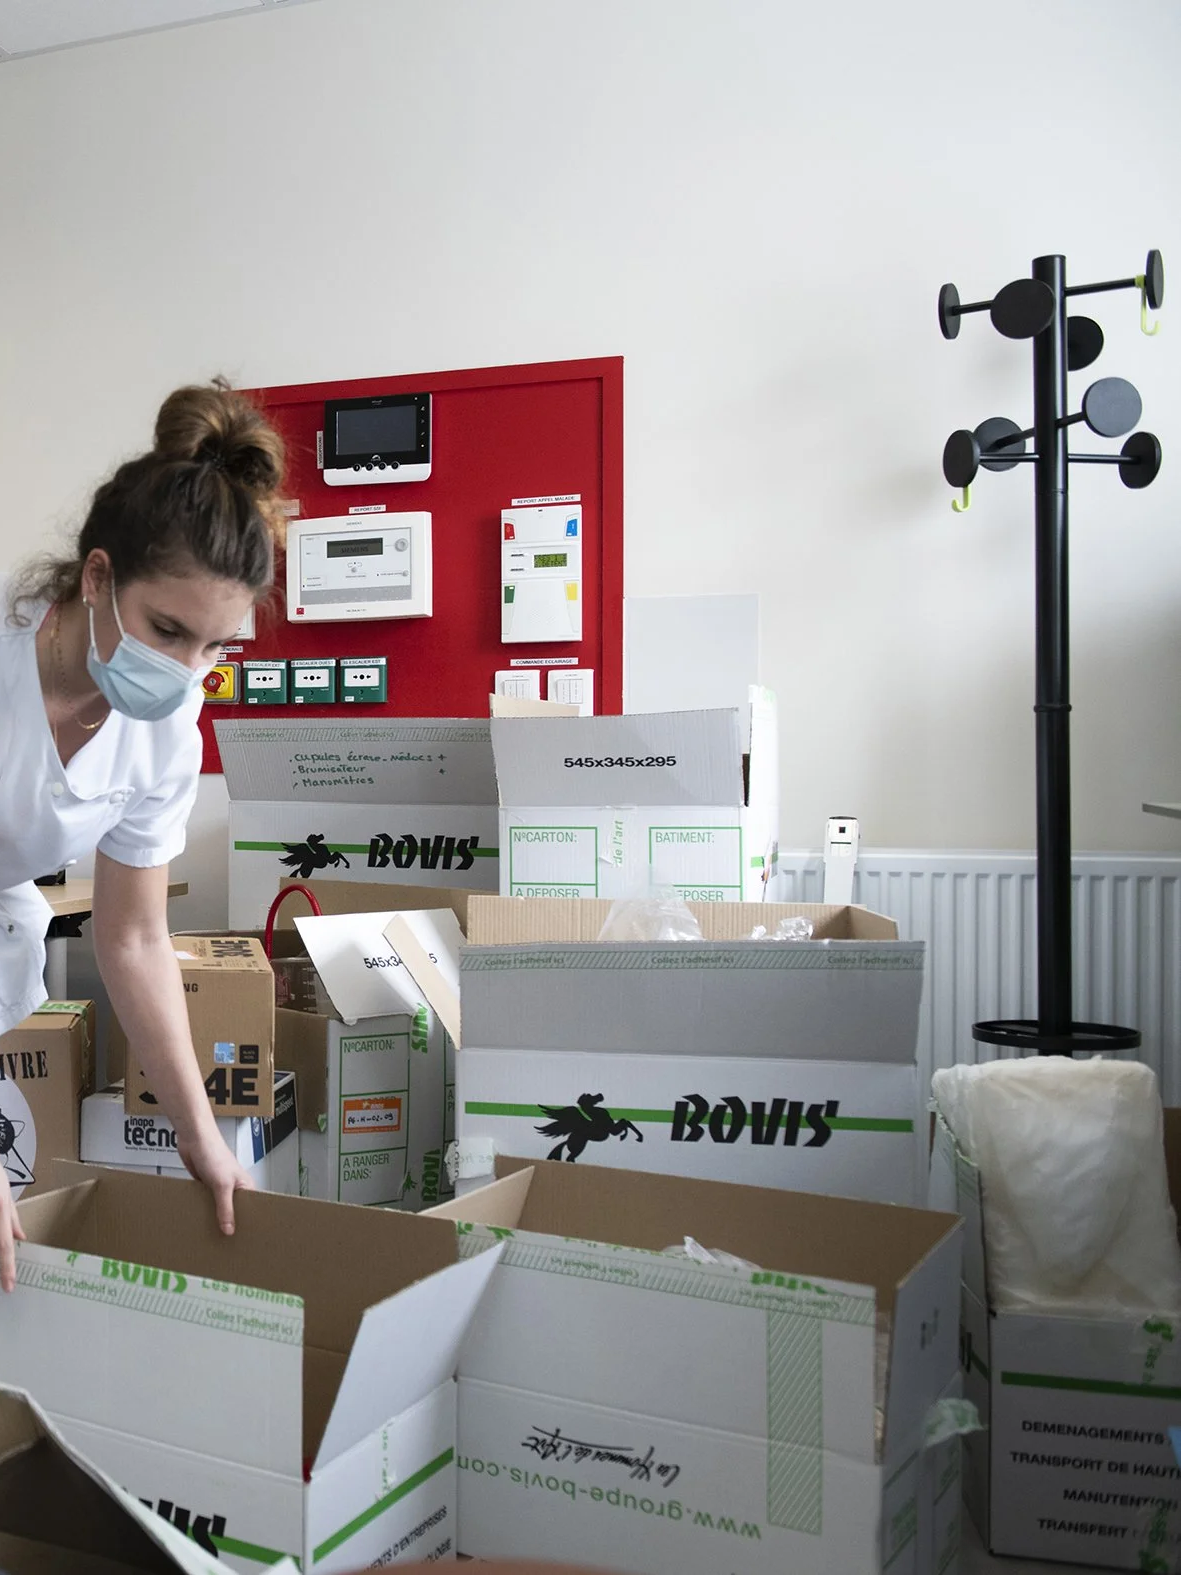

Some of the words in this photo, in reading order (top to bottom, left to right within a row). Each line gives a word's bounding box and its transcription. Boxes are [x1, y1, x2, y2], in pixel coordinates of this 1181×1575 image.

[564, 755, 677, 770] 545x345x295
[655, 831, 715, 844] BATIMENT:
[367, 833, 480, 871] BOVIS
[678, 890, 724, 902] EPOSER
[651, 955, 680, 965] Collez
[130, 1115, 155, 1128] inapa
[670, 1093, 839, 1147] BOVIS
[343, 1155, 351, 1168] A
[352, 1153, 390, 1167] RANGER
[343, 1169, 372, 1182] DANS:
[41, 1271, 68, 1287] Collez
[205, 1307, 236, 1324] Collez
[1022, 1420, 1165, 1446] DEMENAGEMENTS
[1011, 1451, 1105, 1471] TRANSPORT
[1107, 1461, 1129, 1475] DE
[1038, 1518, 1128, 1539] TRANSFERT
